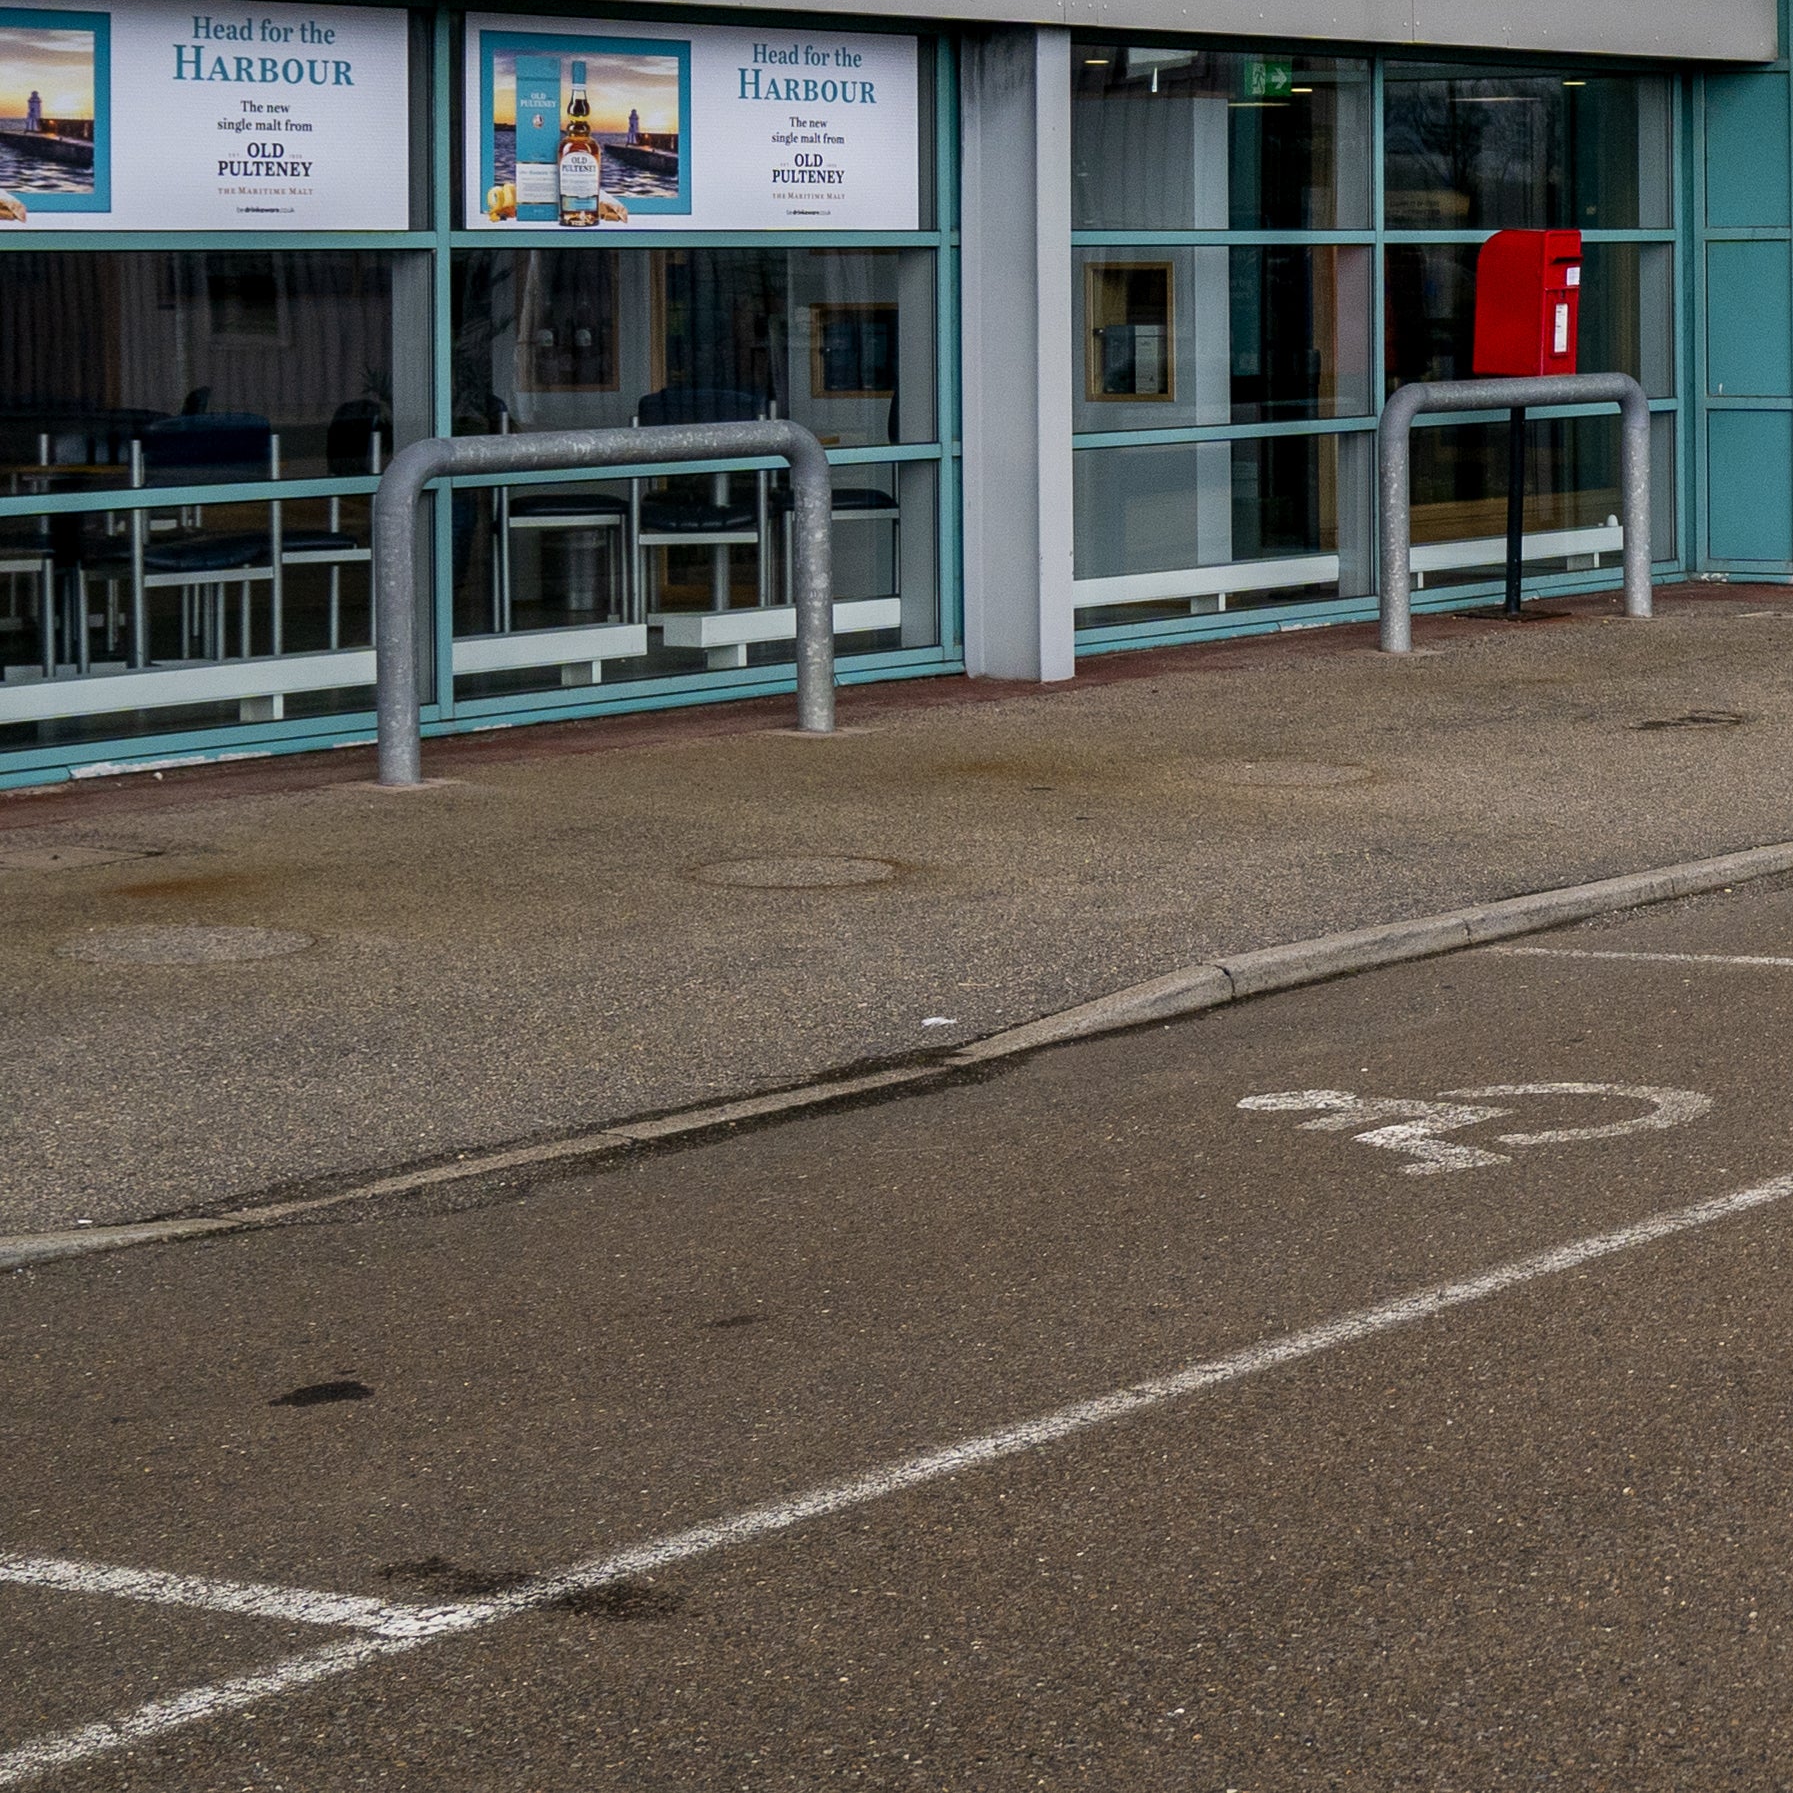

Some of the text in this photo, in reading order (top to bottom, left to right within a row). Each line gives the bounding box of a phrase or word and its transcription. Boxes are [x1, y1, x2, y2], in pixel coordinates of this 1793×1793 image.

[192, 15, 336, 44] Head for the
[752, 43, 862, 68] Head for the
[173, 44, 355, 86] HARBOUR
[738, 68, 877, 103] HARBOUR
[240, 100, 290, 113] The new
[217, 118, 313, 133] single malt from
[789, 116, 827, 128] The new
[771, 132, 845, 146] single malt from
[247, 142, 284, 158] OLD
[794, 153, 823, 167] OLD
[217, 161, 313, 177] PULTENEY
[772, 169, 845, 184] PULTENEY
[218, 187, 236, 195] THE
[289, 187, 313, 195] MALT
